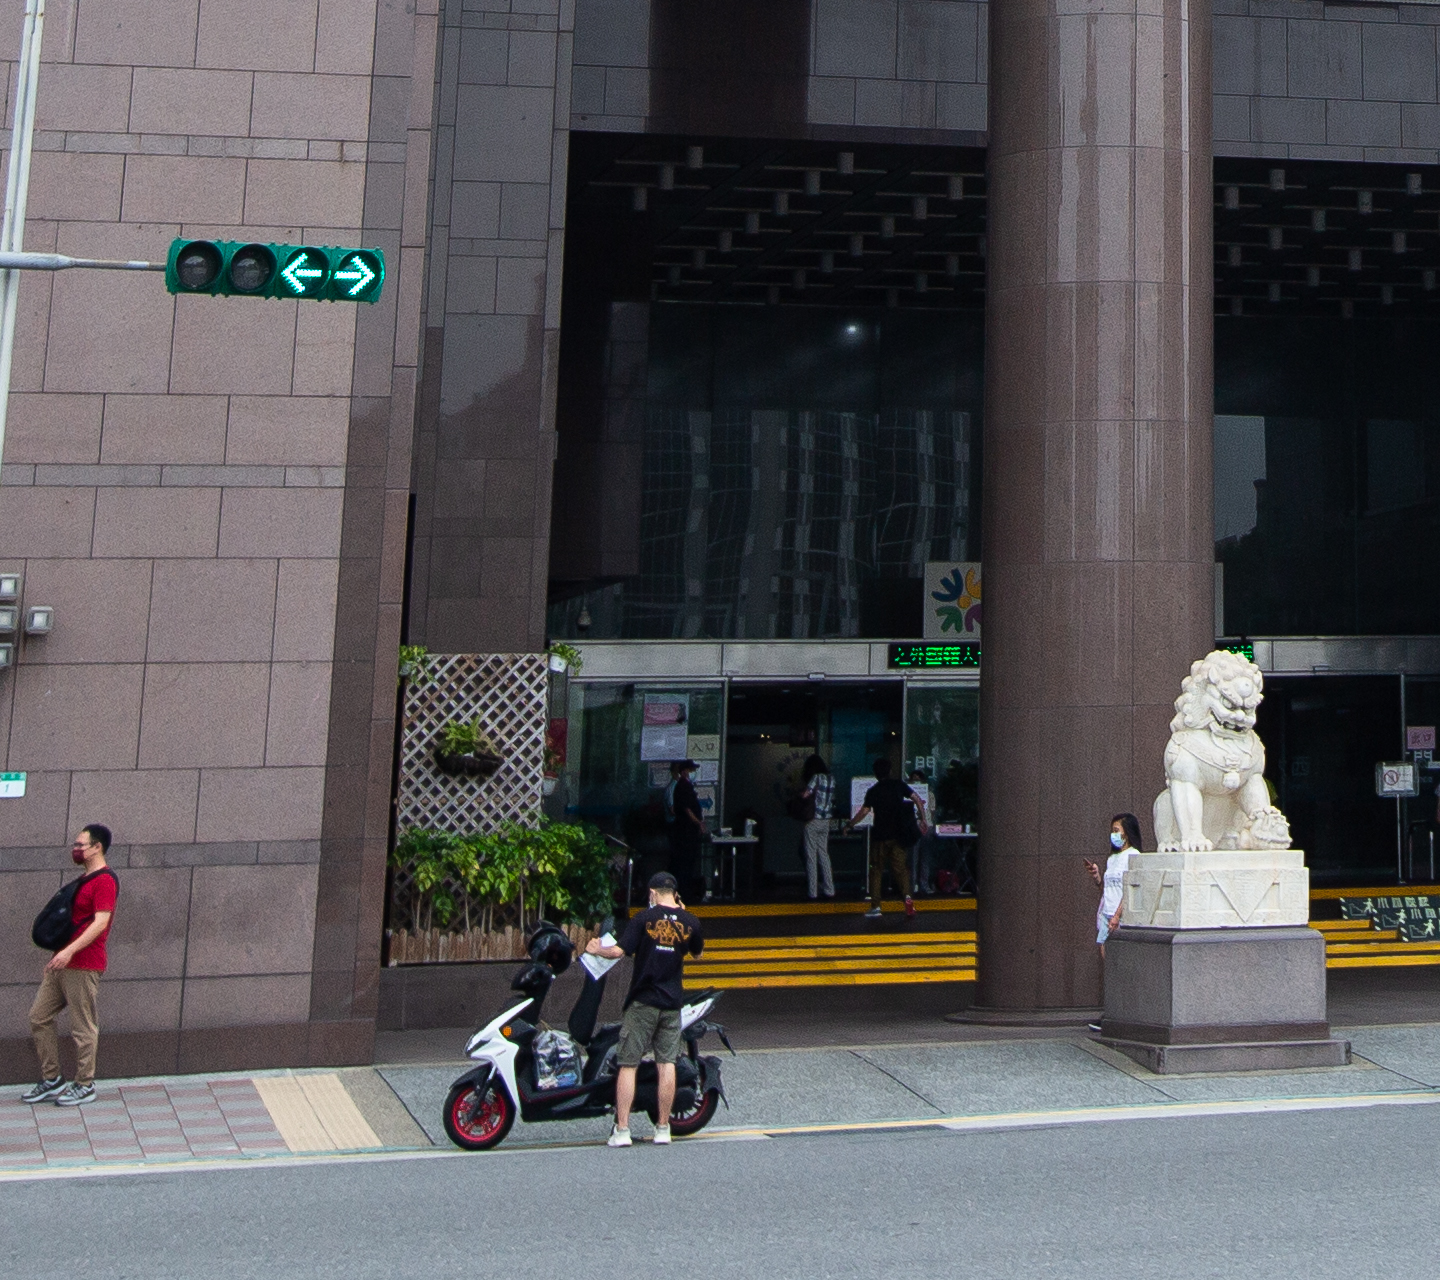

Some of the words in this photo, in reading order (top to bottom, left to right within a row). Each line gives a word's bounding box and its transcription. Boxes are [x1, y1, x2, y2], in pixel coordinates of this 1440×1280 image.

[894, 646, 981, 665] 之外國籍人
